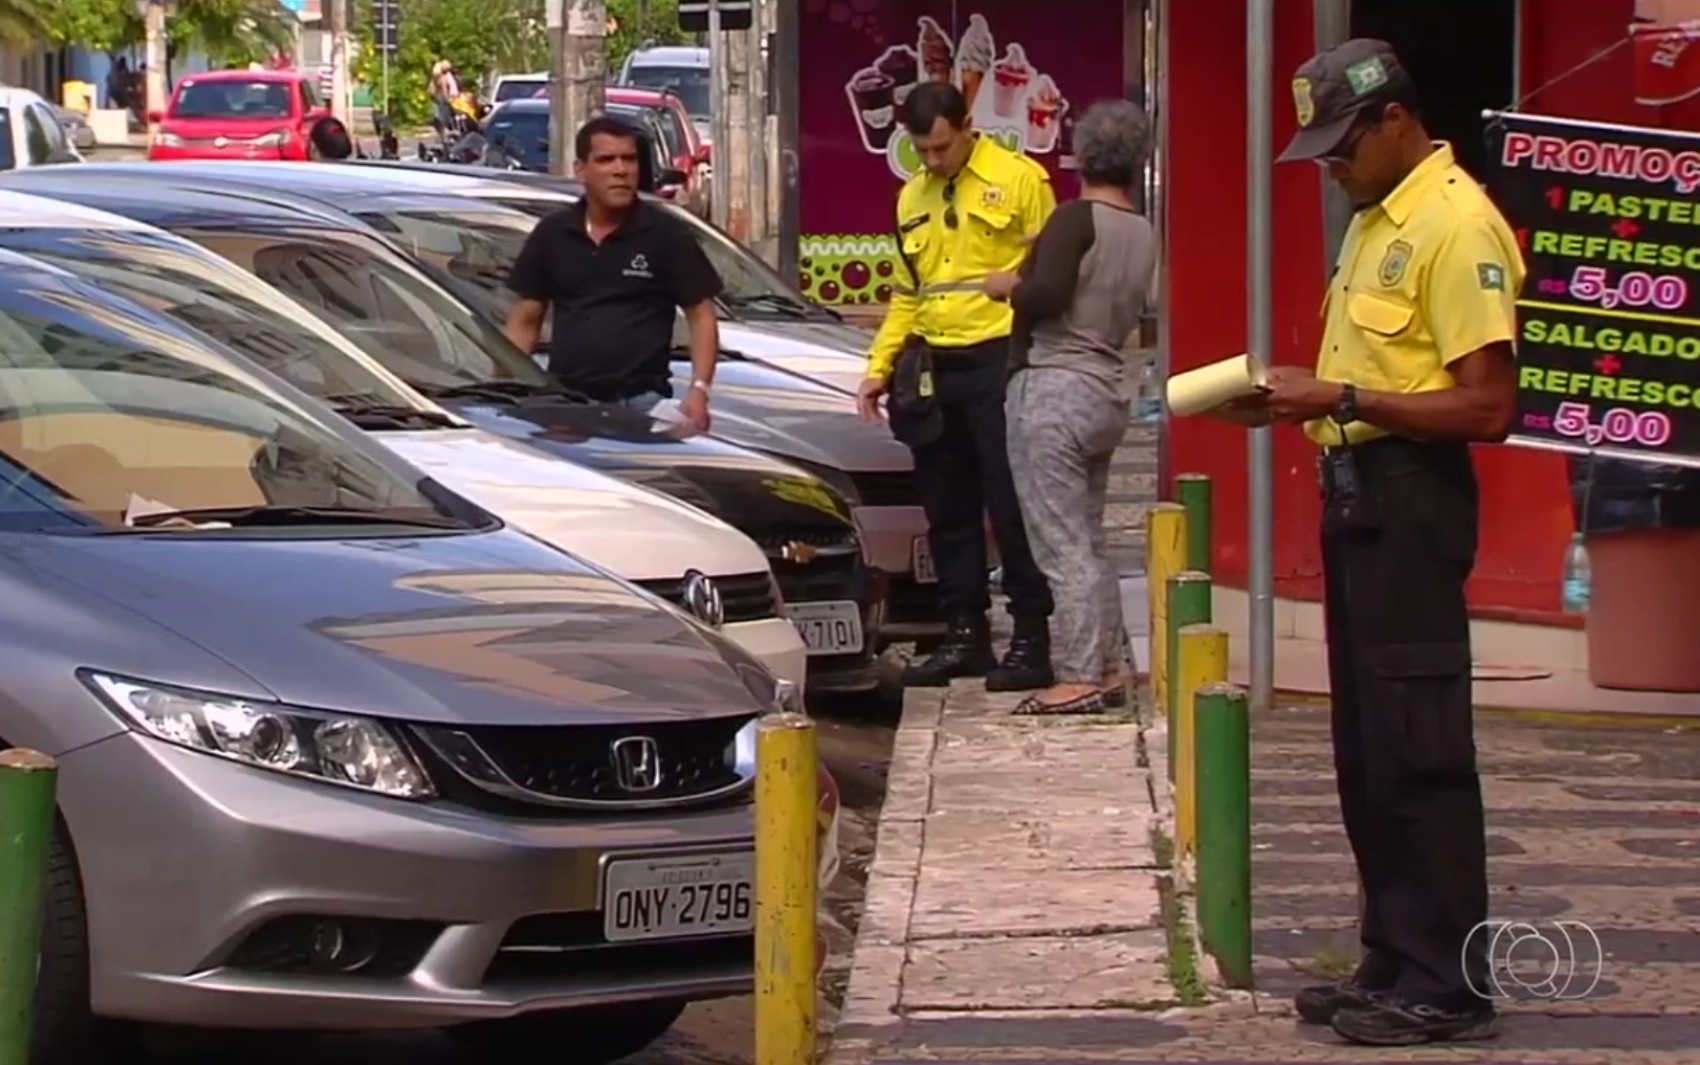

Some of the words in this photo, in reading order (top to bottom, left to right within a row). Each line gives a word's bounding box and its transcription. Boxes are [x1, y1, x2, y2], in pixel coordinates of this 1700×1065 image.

[1502, 132, 1700, 193] PROMOÇ
[1568, 266, 1687, 309] 5,00
[1523, 320, 1700, 360] SALGADO
[1553, 401, 1670, 445] 5,00
